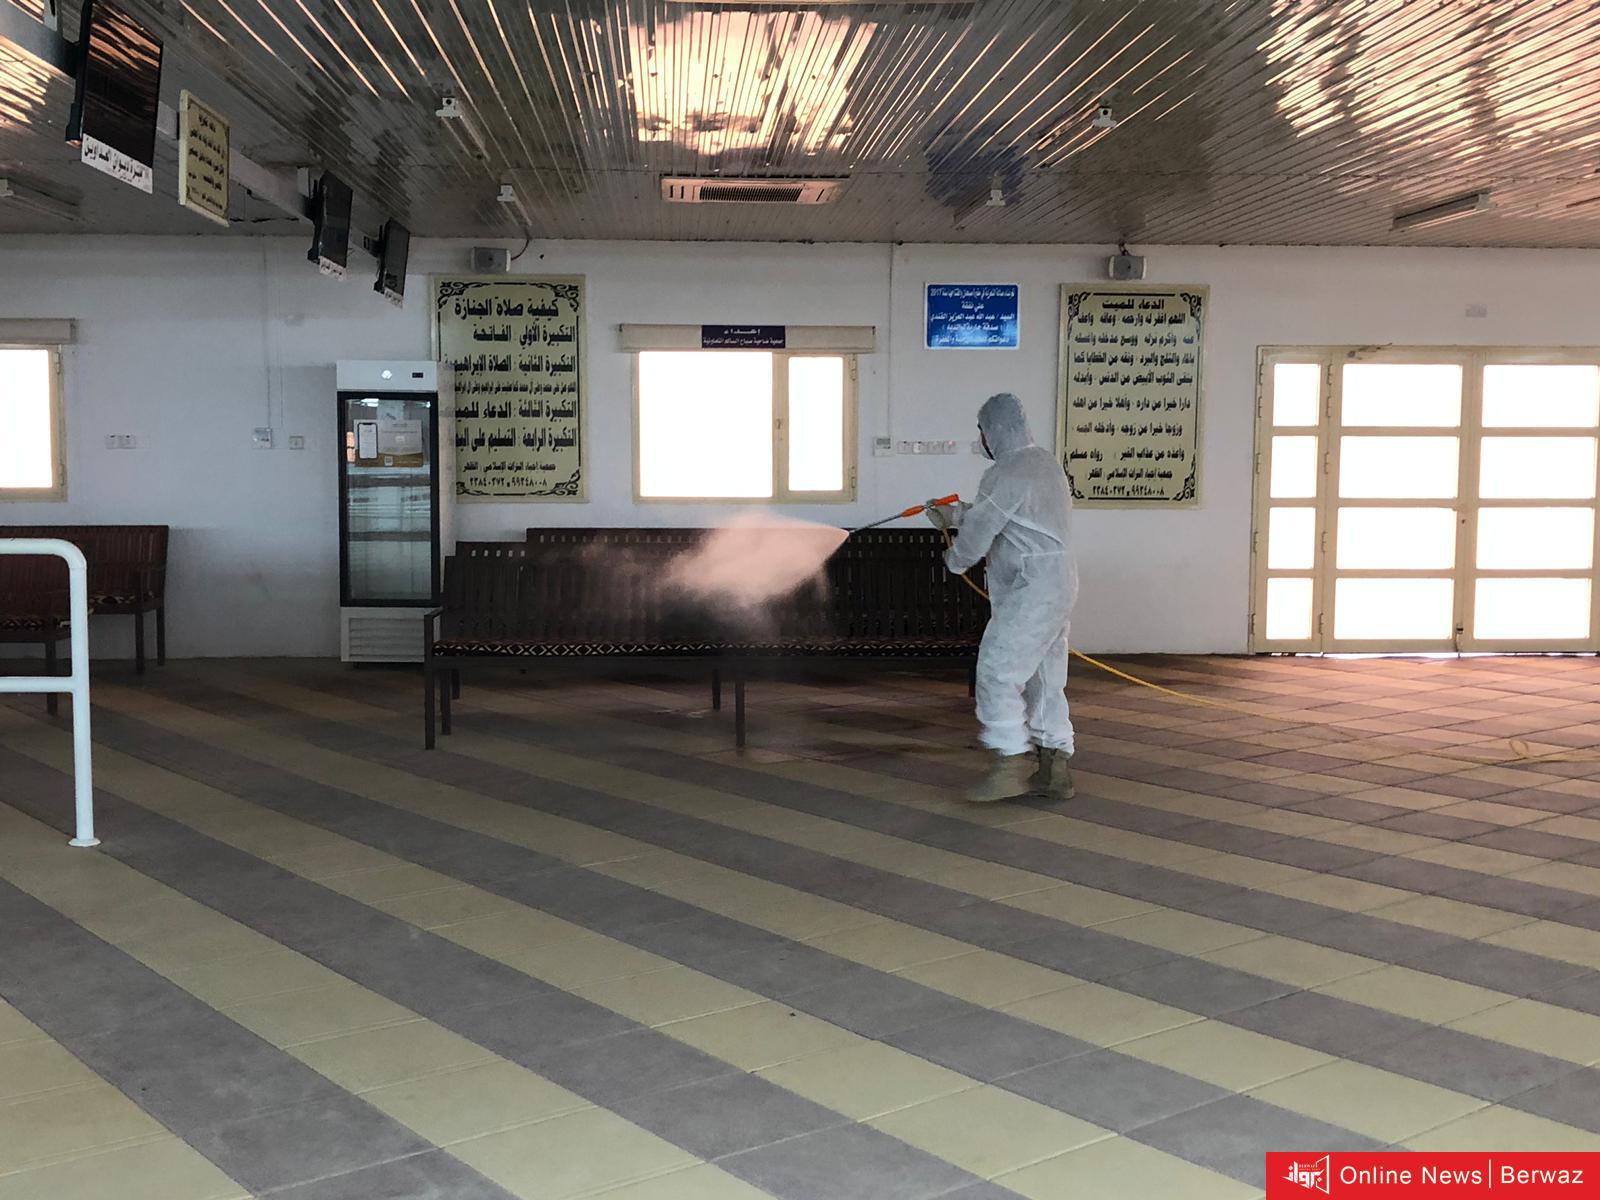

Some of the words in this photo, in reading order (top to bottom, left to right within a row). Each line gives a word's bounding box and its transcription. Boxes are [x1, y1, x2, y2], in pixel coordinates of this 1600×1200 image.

[455, 297, 492, 320] الجنازة
[495, 296, 523, 317] صلاة
[527, 298, 559, 322] كيفية
[1102, 298, 1134, 311] للميت
[1138, 298, 1164, 310] الدعاء
[1145, 312, 1152, 325] له
[1153, 312, 1167, 326] اغفر
[1168, 312, 1186, 325] اللهم
[473, 323, 511, 342] الفاتحة
[542, 324, 576, 347] التكبيرة
[489, 353, 511, 372] الصلاة
[519, 354, 543, 377] الثانية
[545, 354, 576, 377] التكبيرة
[455, 401, 479, 422] للمي
[483, 401, 511, 418] الدعاء
[519, 399, 543, 418] الثالثة
[545, 399, 576, 422] التكبيرة
[471, 427, 485, 452] على
[488, 427, 515, 453] التسليم
[522, 427, 546, 452] الرابعة
[548, 427, 576, 452] التكبيرة
